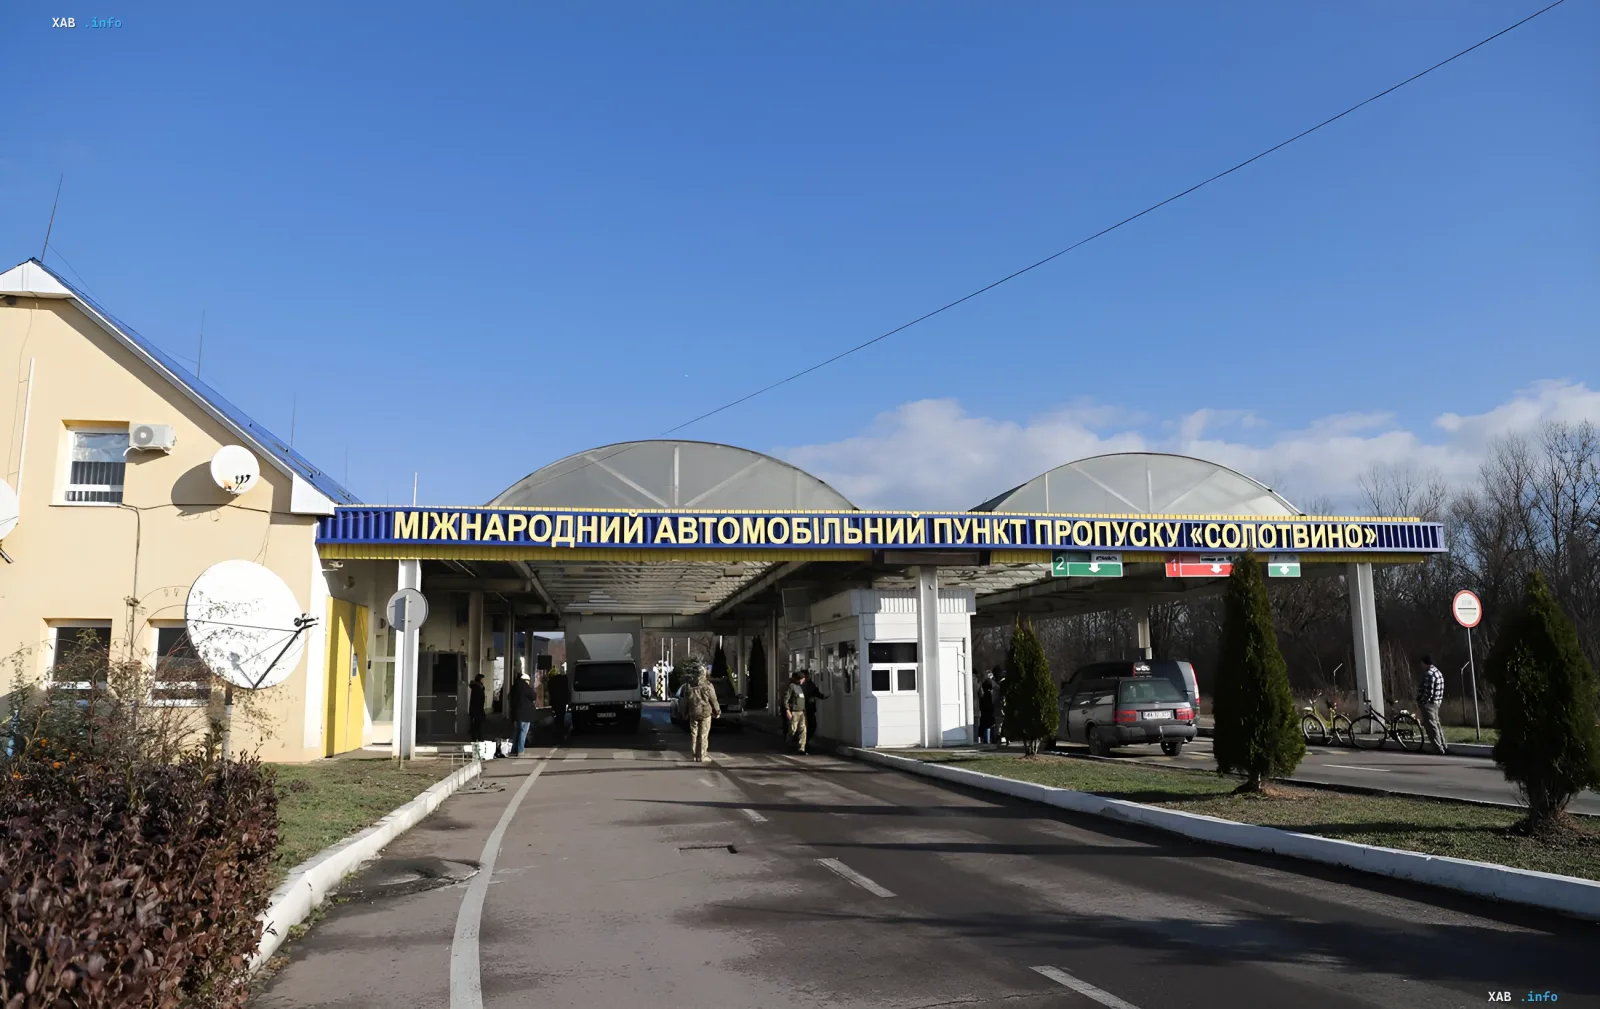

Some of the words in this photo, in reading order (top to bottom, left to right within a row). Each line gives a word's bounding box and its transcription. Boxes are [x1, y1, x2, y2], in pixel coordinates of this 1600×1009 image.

[393, 511, 644, 548] МІЖНАРОДНИЙ
[653, 512, 926, 545] АВТОМОБІЛЬНИЙ
[933, 518, 1027, 544] ПУНКТ
[1034, 519, 1180, 547] ПРОПУСКУ
[1190, 523, 1377, 549] «СОЛОТВИНО»
[1055, 556, 1065, 570] 2
[1171, 558, 1177, 572] 1
